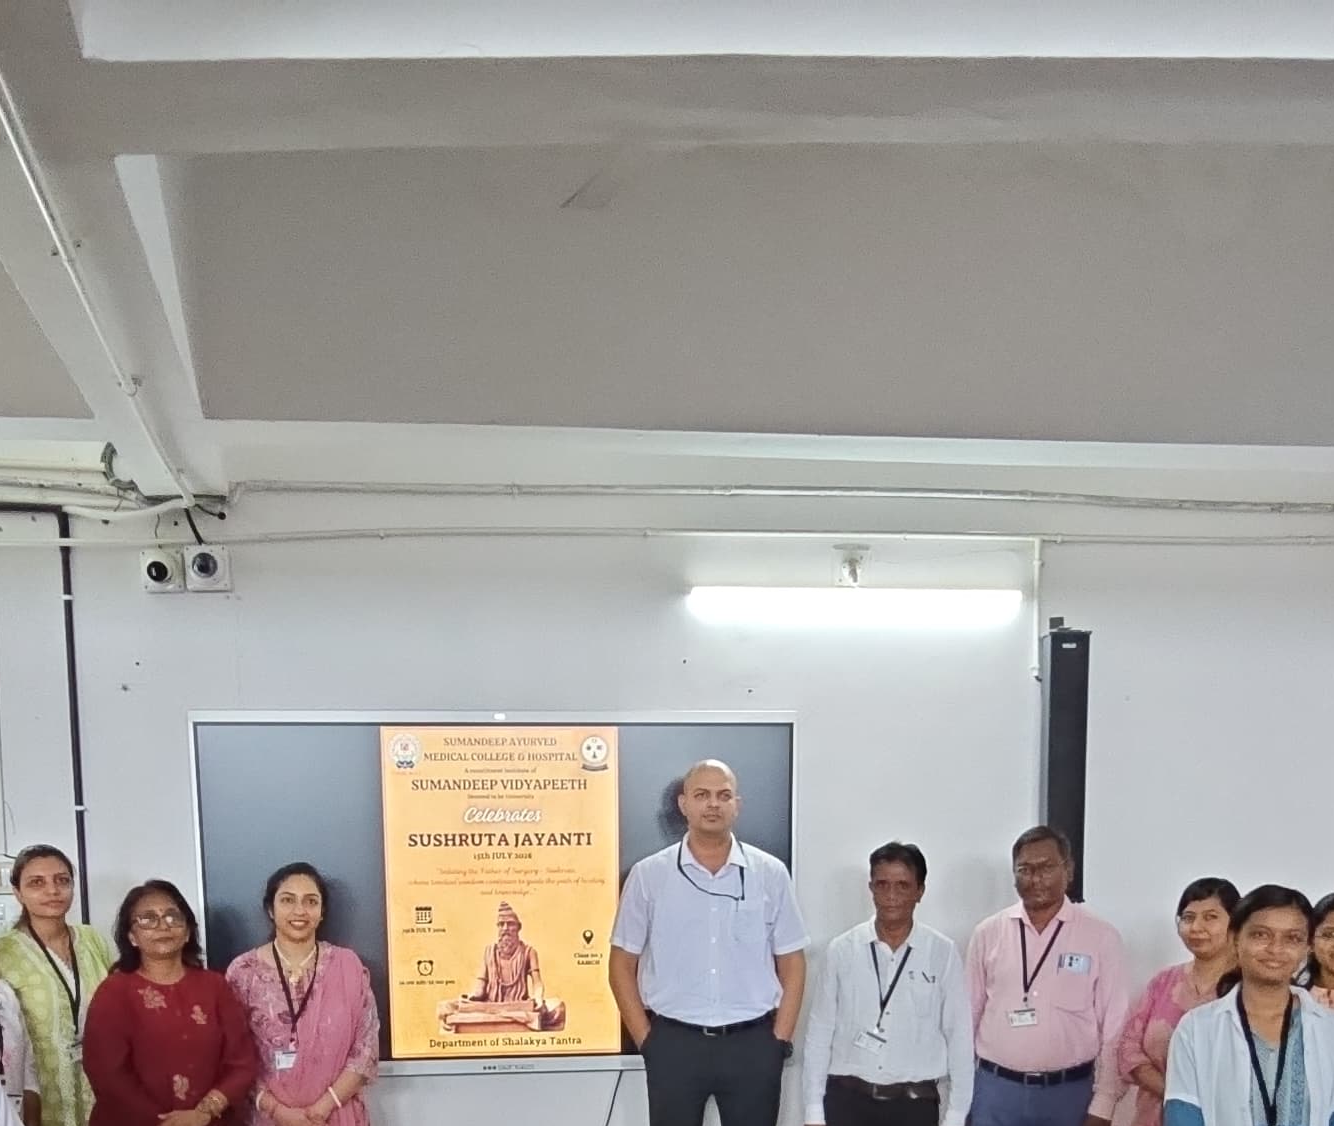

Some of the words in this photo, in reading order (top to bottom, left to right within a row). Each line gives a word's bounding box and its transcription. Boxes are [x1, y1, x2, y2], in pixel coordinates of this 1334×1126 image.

[443, 736, 507, 746] SUMANDEEP
[509, 736, 557, 746] AYURVED
[423, 752, 469, 761] MEDICAL
[471, 752, 515, 761] COLLEGE
[528, 752, 578, 761] HOSPITAL
[411, 779, 498, 791] SUMANDEEP
[500, 779, 588, 790] VIDYAPEETH
[464, 807, 542, 823] Celebrates
[408, 833, 510, 847] SUSHRUTA
[514, 832, 592, 848] JAYANTI
[492, 852, 513, 860] JULY
[429, 1039, 487, 1049] Department
[490, 1038, 499, 1047] of
[502, 1037, 547, 1047] Shalakya
[549, 1036, 582, 1045] Tantra
